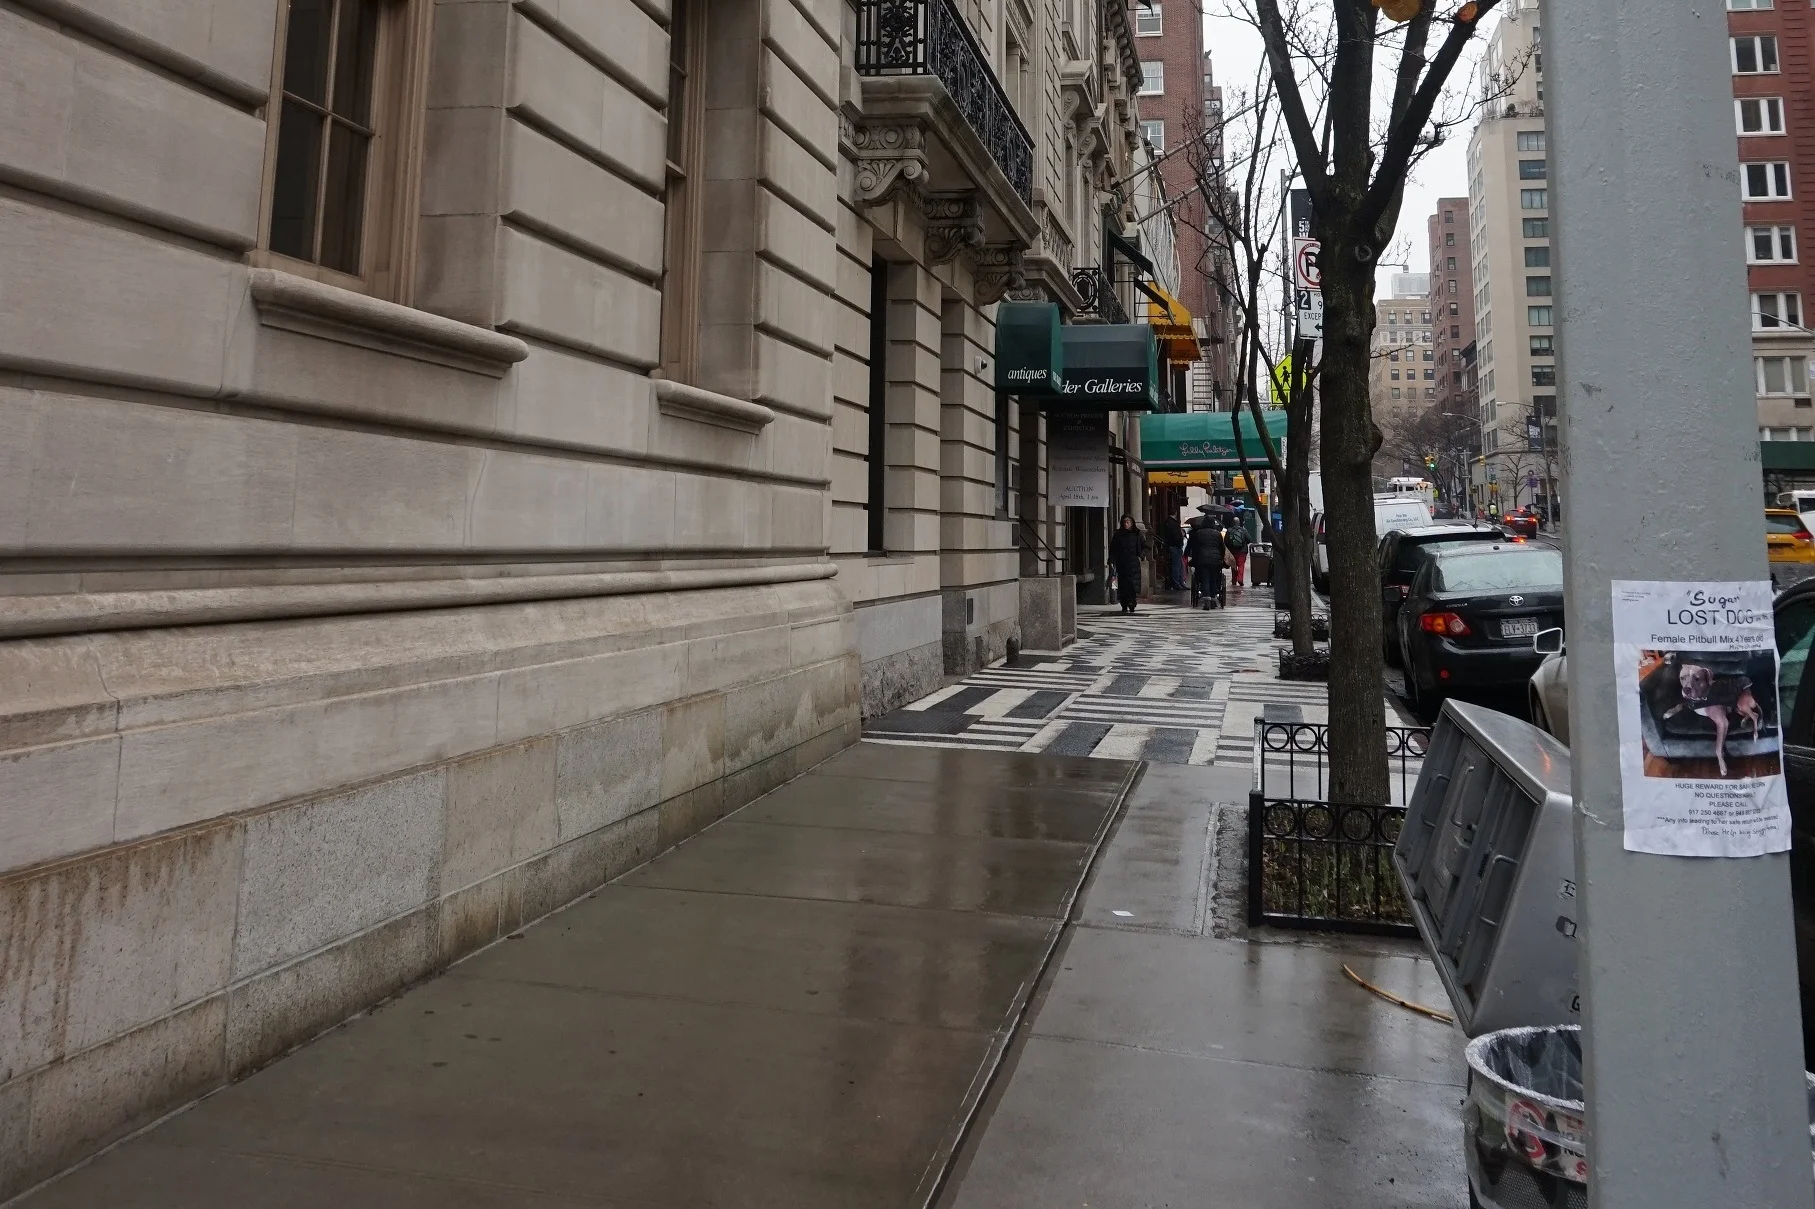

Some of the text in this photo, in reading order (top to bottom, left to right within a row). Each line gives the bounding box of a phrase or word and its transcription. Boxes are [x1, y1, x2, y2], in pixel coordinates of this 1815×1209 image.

[1300, 290, 1310, 309] 2
[1303, 312, 1322, 321] EXCEP
[1007, 366, 1048, 384] antiques
[1062, 378, 1143, 394] der Galleries
[1667, 609, 1720, 625] LOST
[1726, 609, 1754, 625] DOG
[1651, 634, 1686, 643] Female
[1688, 634, 1717, 643] Pitbull
